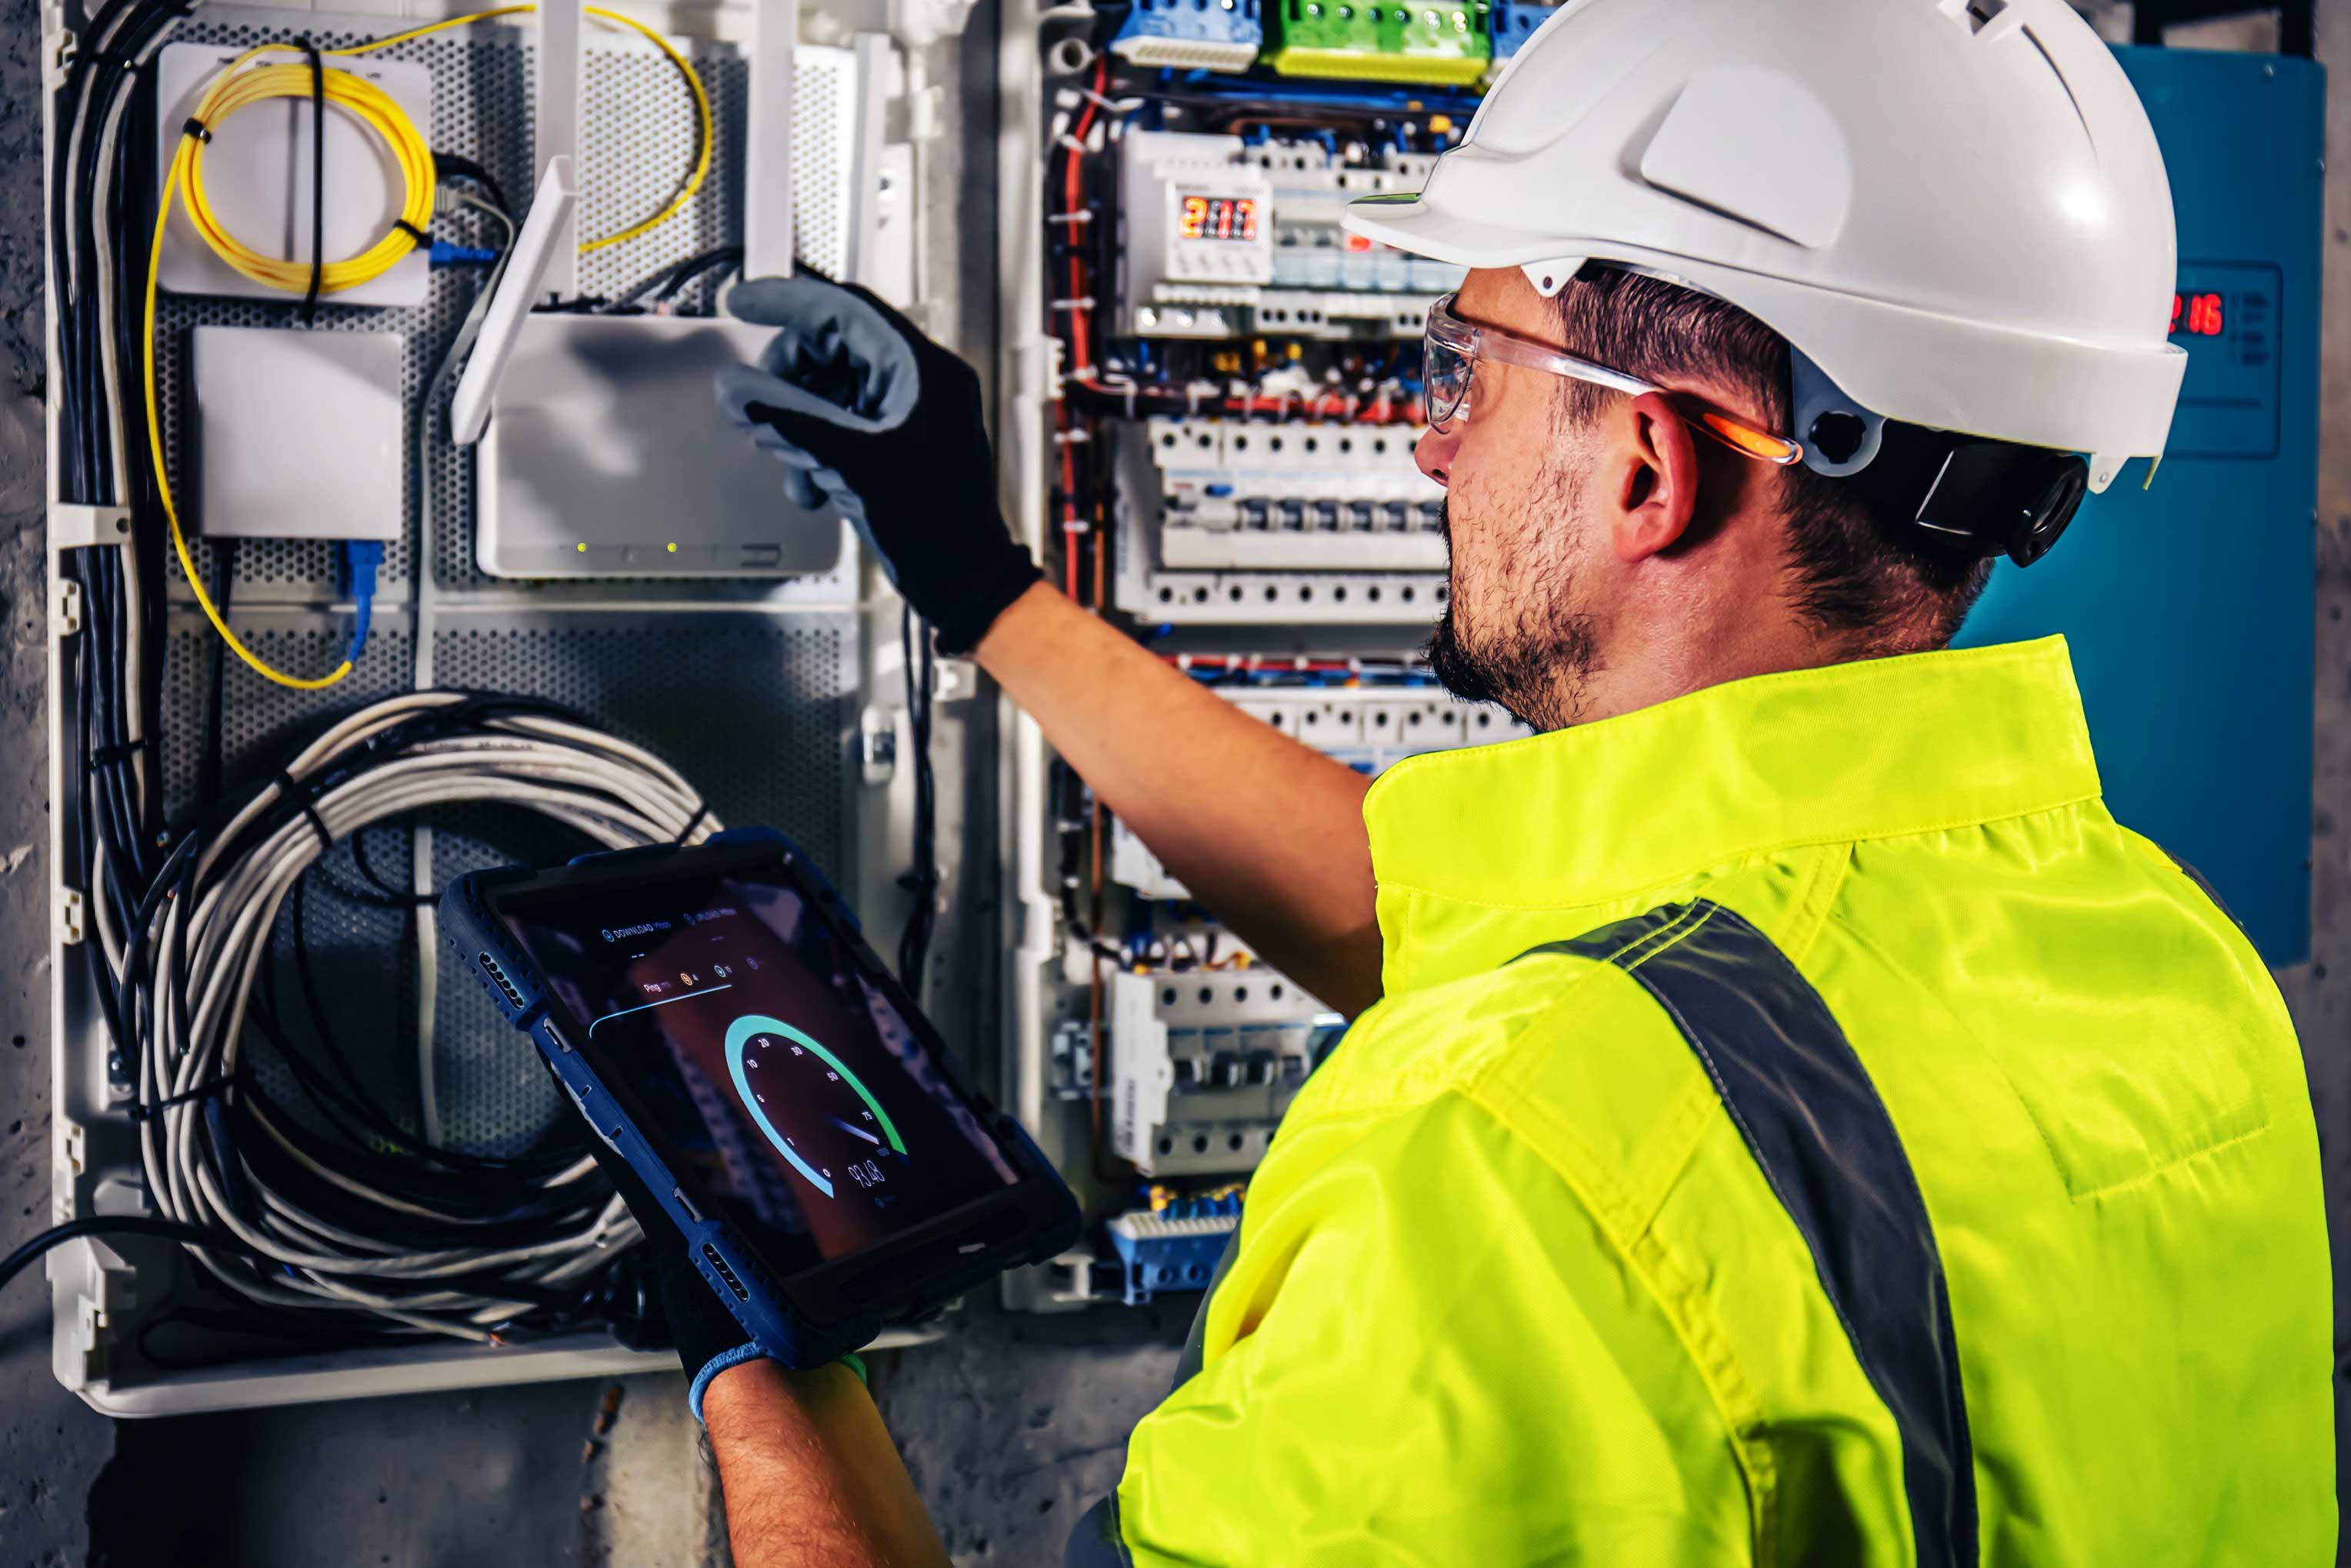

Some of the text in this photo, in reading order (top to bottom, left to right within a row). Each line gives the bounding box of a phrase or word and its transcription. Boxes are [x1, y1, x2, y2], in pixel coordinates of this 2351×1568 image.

[1180, 197, 1259, 240] 217
[613, 923, 654, 939] DOWNLOAD
[643, 982, 662, 993] Ping
[759, 1038, 770, 1048] 20
[791, 1046, 802, 1056] 30
[747, 1059, 759, 1069] 10
[757, 1093, 765, 1103] 5
[862, 1111, 873, 1121] 75
[822, 1168, 831, 1178] 0
[848, 1159, 885, 1189] 93.48
